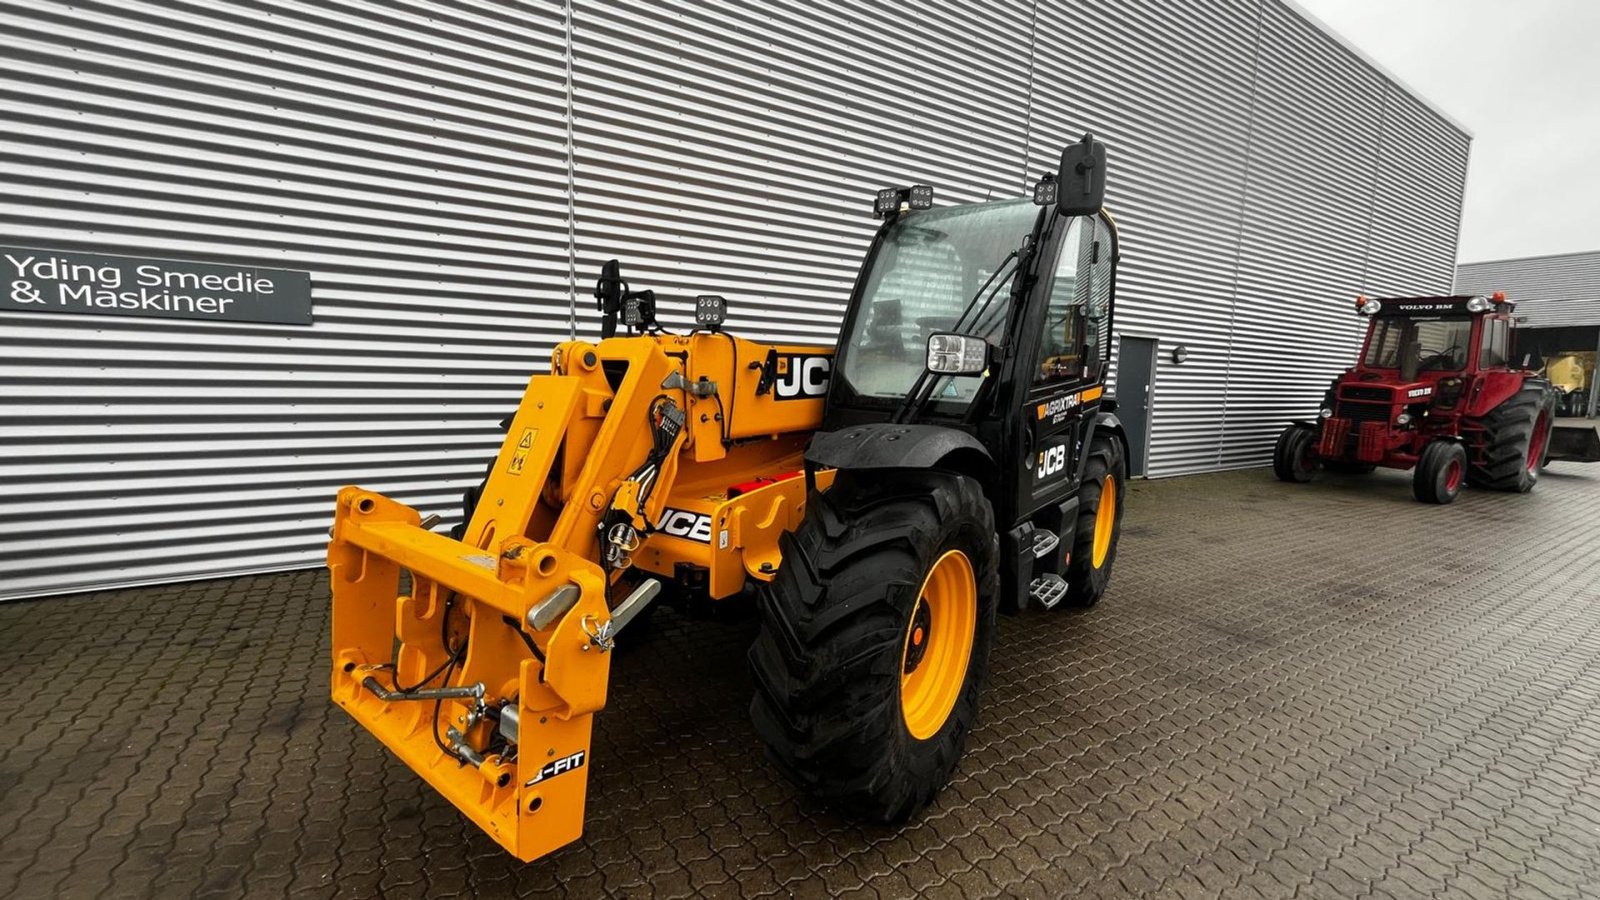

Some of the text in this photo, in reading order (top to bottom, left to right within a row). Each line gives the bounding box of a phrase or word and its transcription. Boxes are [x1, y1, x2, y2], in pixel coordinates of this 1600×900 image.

[4, 253, 274, 294] Yding Smedie
[10, 280, 234, 314] & Maskiner
[776, 357, 830, 397] JC
[1037, 444, 1066, 479] JCB
[656, 509, 712, 543] JCB
